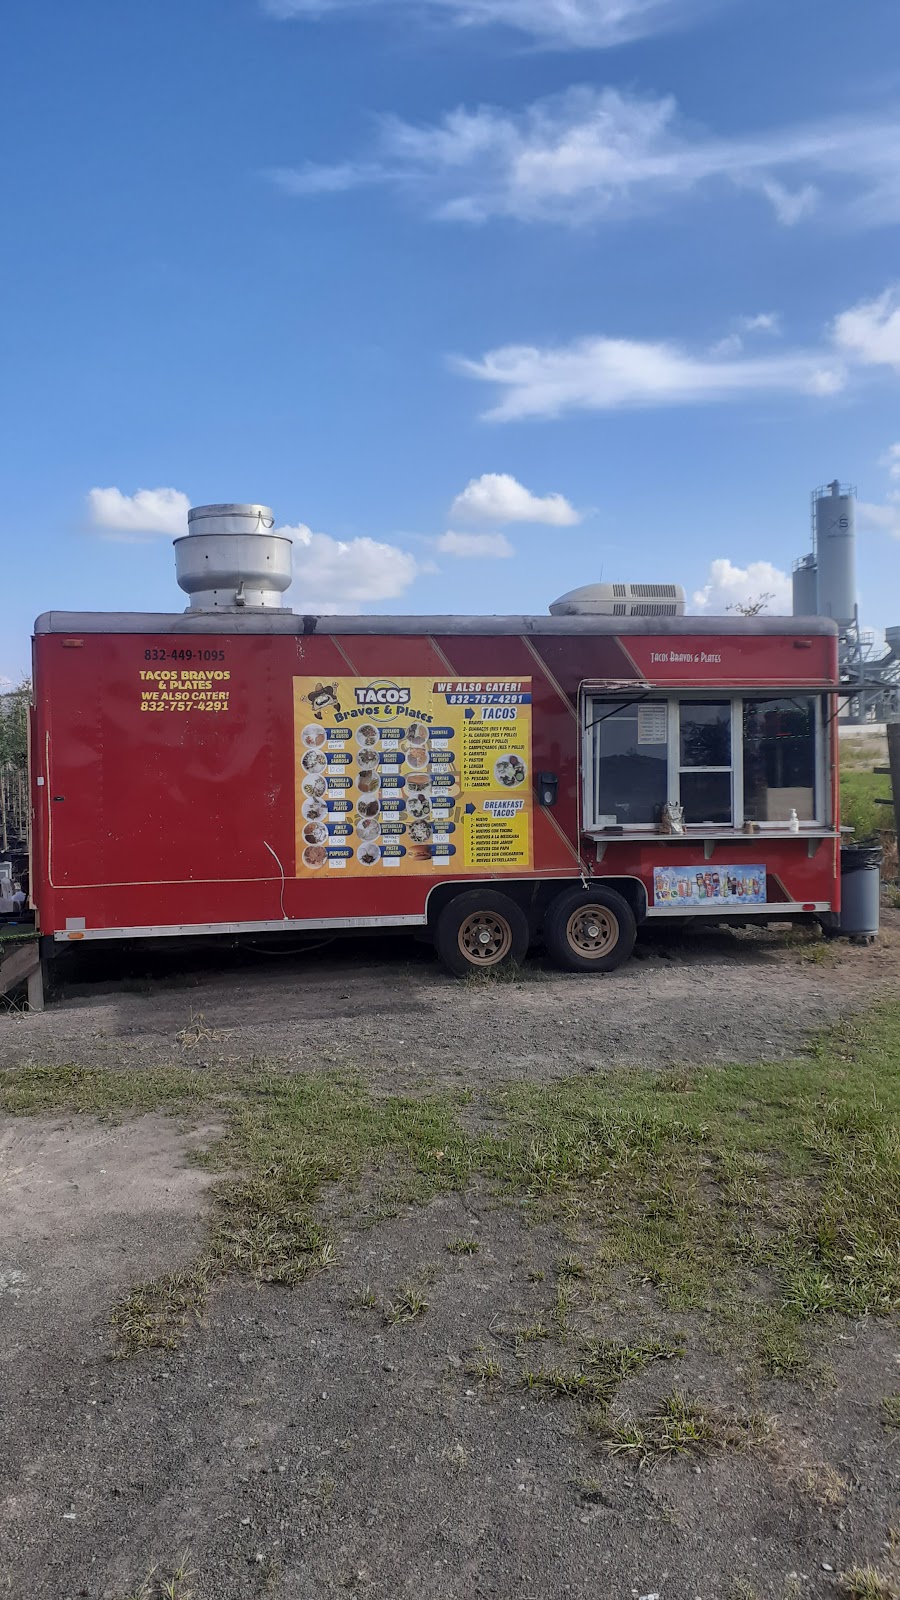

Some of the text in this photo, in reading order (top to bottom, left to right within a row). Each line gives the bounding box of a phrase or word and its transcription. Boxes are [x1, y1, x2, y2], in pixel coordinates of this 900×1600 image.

[144, 649, 225, 661] 832-449-1095
[650, 652, 668, 663] TACOS
[670, 651, 693, 662] BRAVOS
[700, 652, 721, 663] PLATES
[139, 670, 230, 680] TACOS BRAVOS
[158, 680, 212, 690] & PLATES
[437, 683, 521, 692] WE ALSO CATER!
[142, 692, 230, 700] WE ALSO CATER!
[356, 688, 410, 704] TACOS
[450, 695, 523, 704] 832-757-4291
[140, 701, 228, 711] 832-757-4291
[334, 705, 433, 723] Bravos & Plates
[482, 708, 516, 719] TACOS
